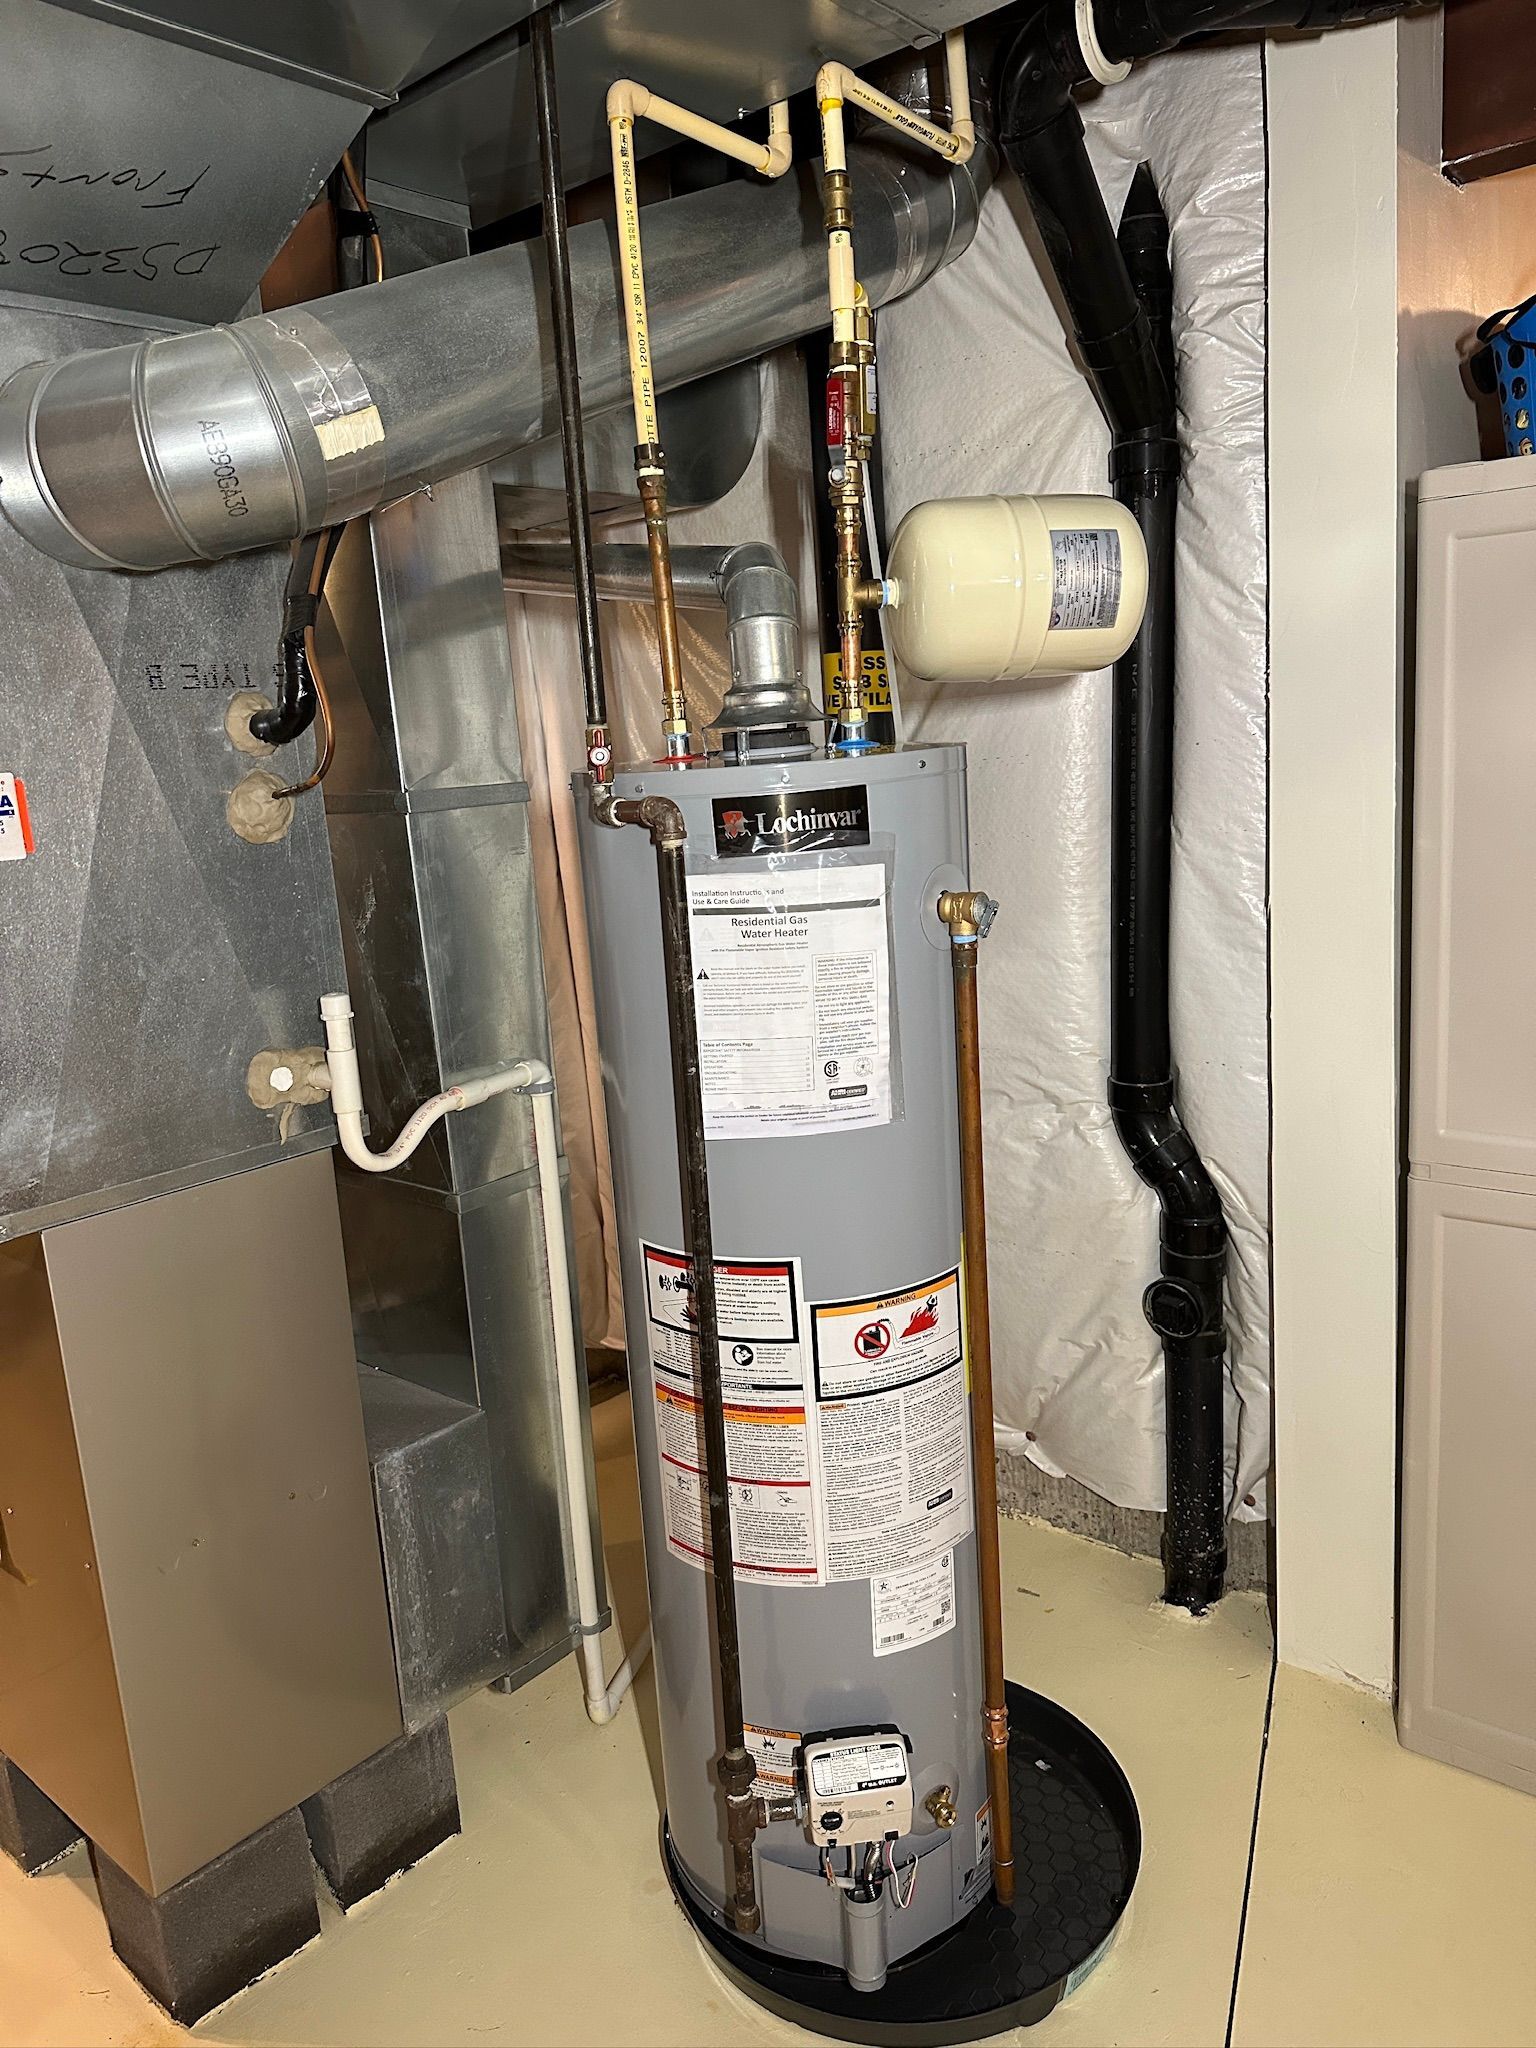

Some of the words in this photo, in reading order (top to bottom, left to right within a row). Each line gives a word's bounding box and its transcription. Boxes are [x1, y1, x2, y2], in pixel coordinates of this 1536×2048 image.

[622, 160, 631, 185] D-2846
[625, 187, 633, 205] ASTM
[630, 244, 638, 260] 4120
[631, 262, 640, 280] CPVC
[634, 293, 642, 306] SDR
[637, 332, 648, 368] 12007
[643, 377, 652, 407] PIPE
[755, 808, 862, 835] Lochinvar
[731, 917, 786, 927] Residential
[789, 916, 808, 924] Gas
[741, 929, 771, 938] Water
[774, 928, 808, 937] Heater
[884, 1293, 917, 1308] WARNING
[758, 1728, 786, 1737] WARNING
[759, 1774, 790, 1783] WARNING
